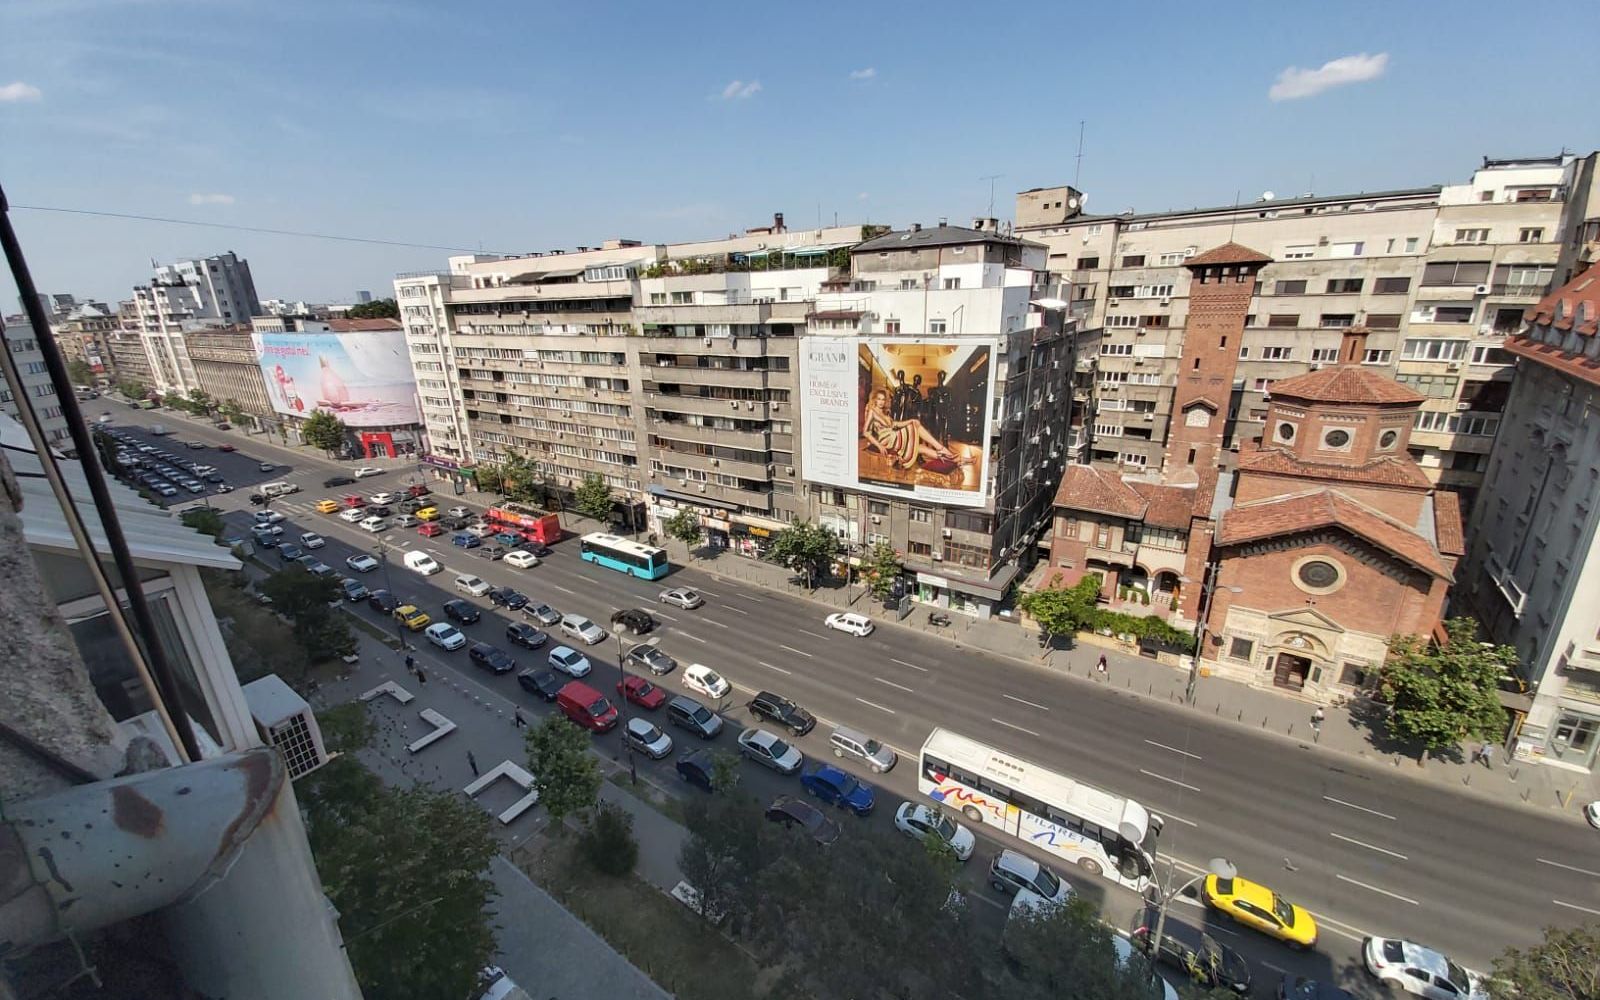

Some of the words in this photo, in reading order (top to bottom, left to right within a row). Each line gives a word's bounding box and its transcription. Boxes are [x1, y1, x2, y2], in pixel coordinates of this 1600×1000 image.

[810, 352, 846, 363] GRAND
[809, 380, 829, 388] HOME
[809, 388, 849, 399] EXCLUSIVE
[820, 398, 849, 407] BRANDS
[1025, 813, 1087, 843] FILARET
